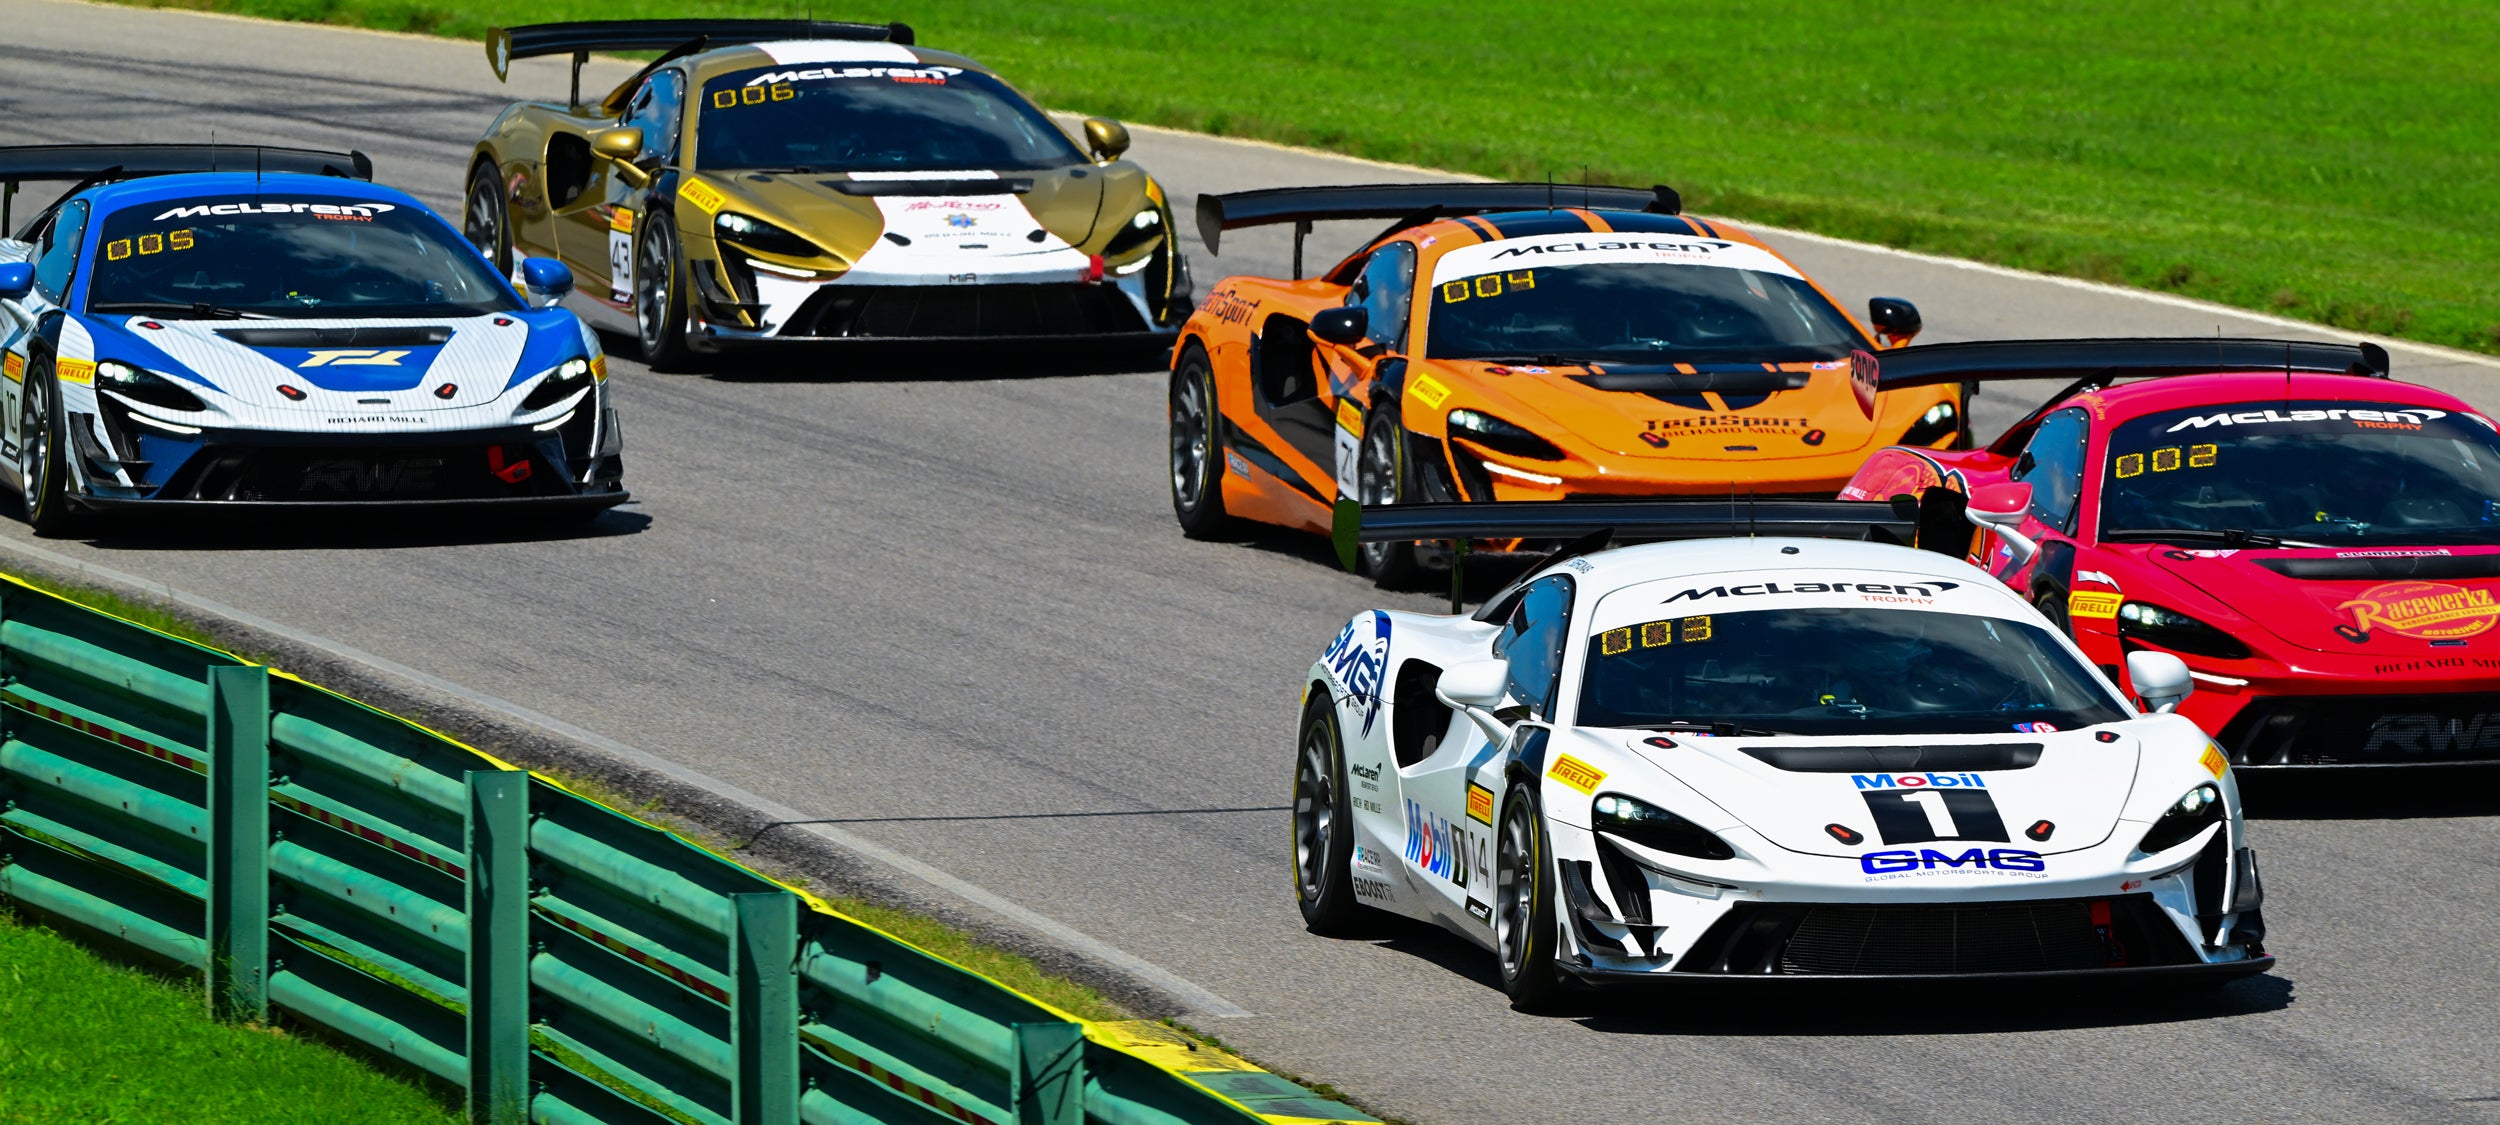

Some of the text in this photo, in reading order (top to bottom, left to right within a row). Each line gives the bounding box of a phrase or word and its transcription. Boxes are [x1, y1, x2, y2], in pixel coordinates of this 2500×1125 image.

[746, 67, 963, 86] McLaren
[713, 82, 795, 109] 006
[684, 182, 719, 209] PIRELLI
[153, 203, 395, 221] McLaren
[314, 213, 373, 223] TROPHY
[107, 229, 194, 261] 005
[1490, 241, 1732, 260] McLaren
[612, 240, 630, 279] 43
[1443, 270, 1535, 303] 004
[57, 361, 94, 380] PIRELLI
[6, 390, 17, 434] 10
[327, 415, 428, 424] RICHARD MILLE
[1642, 415, 1809, 431] TechSport
[2166, 408, 2448, 433] McLaren
[1661, 427, 1801, 438] RICHARD MILLE
[2352, 419, 2424, 432] TROPHY
[2115, 443, 2218, 479] 002
[1658, 581, 1961, 605] McLaren
[1860, 594, 1934, 606] TROPHY
[2070, 596, 2117, 614] PIRELLI
[2334, 587, 2494, 632] Racewerkz
[1601, 615, 1711, 656] 003
[2422, 619, 2484, 636] MOTORSPORT
[2375, 657, 2465, 674] RICHARD
[1351, 762, 1382, 782] McLaren
[1552, 757, 1602, 790] PIRELLI
[1851, 773, 1985, 789] Mobil
[1470, 790, 1490, 818] PIRELLI
[1901, 791, 1960, 838] 1
[1405, 798, 1451, 880] Mobil
[1470, 831, 1489, 888] 14
[1860, 848, 2045, 874] GMG
[1865, 869, 2049, 883] GLOBAL MOTORSPORTS GROUP
[1353, 876, 1388, 901] EBOOST
